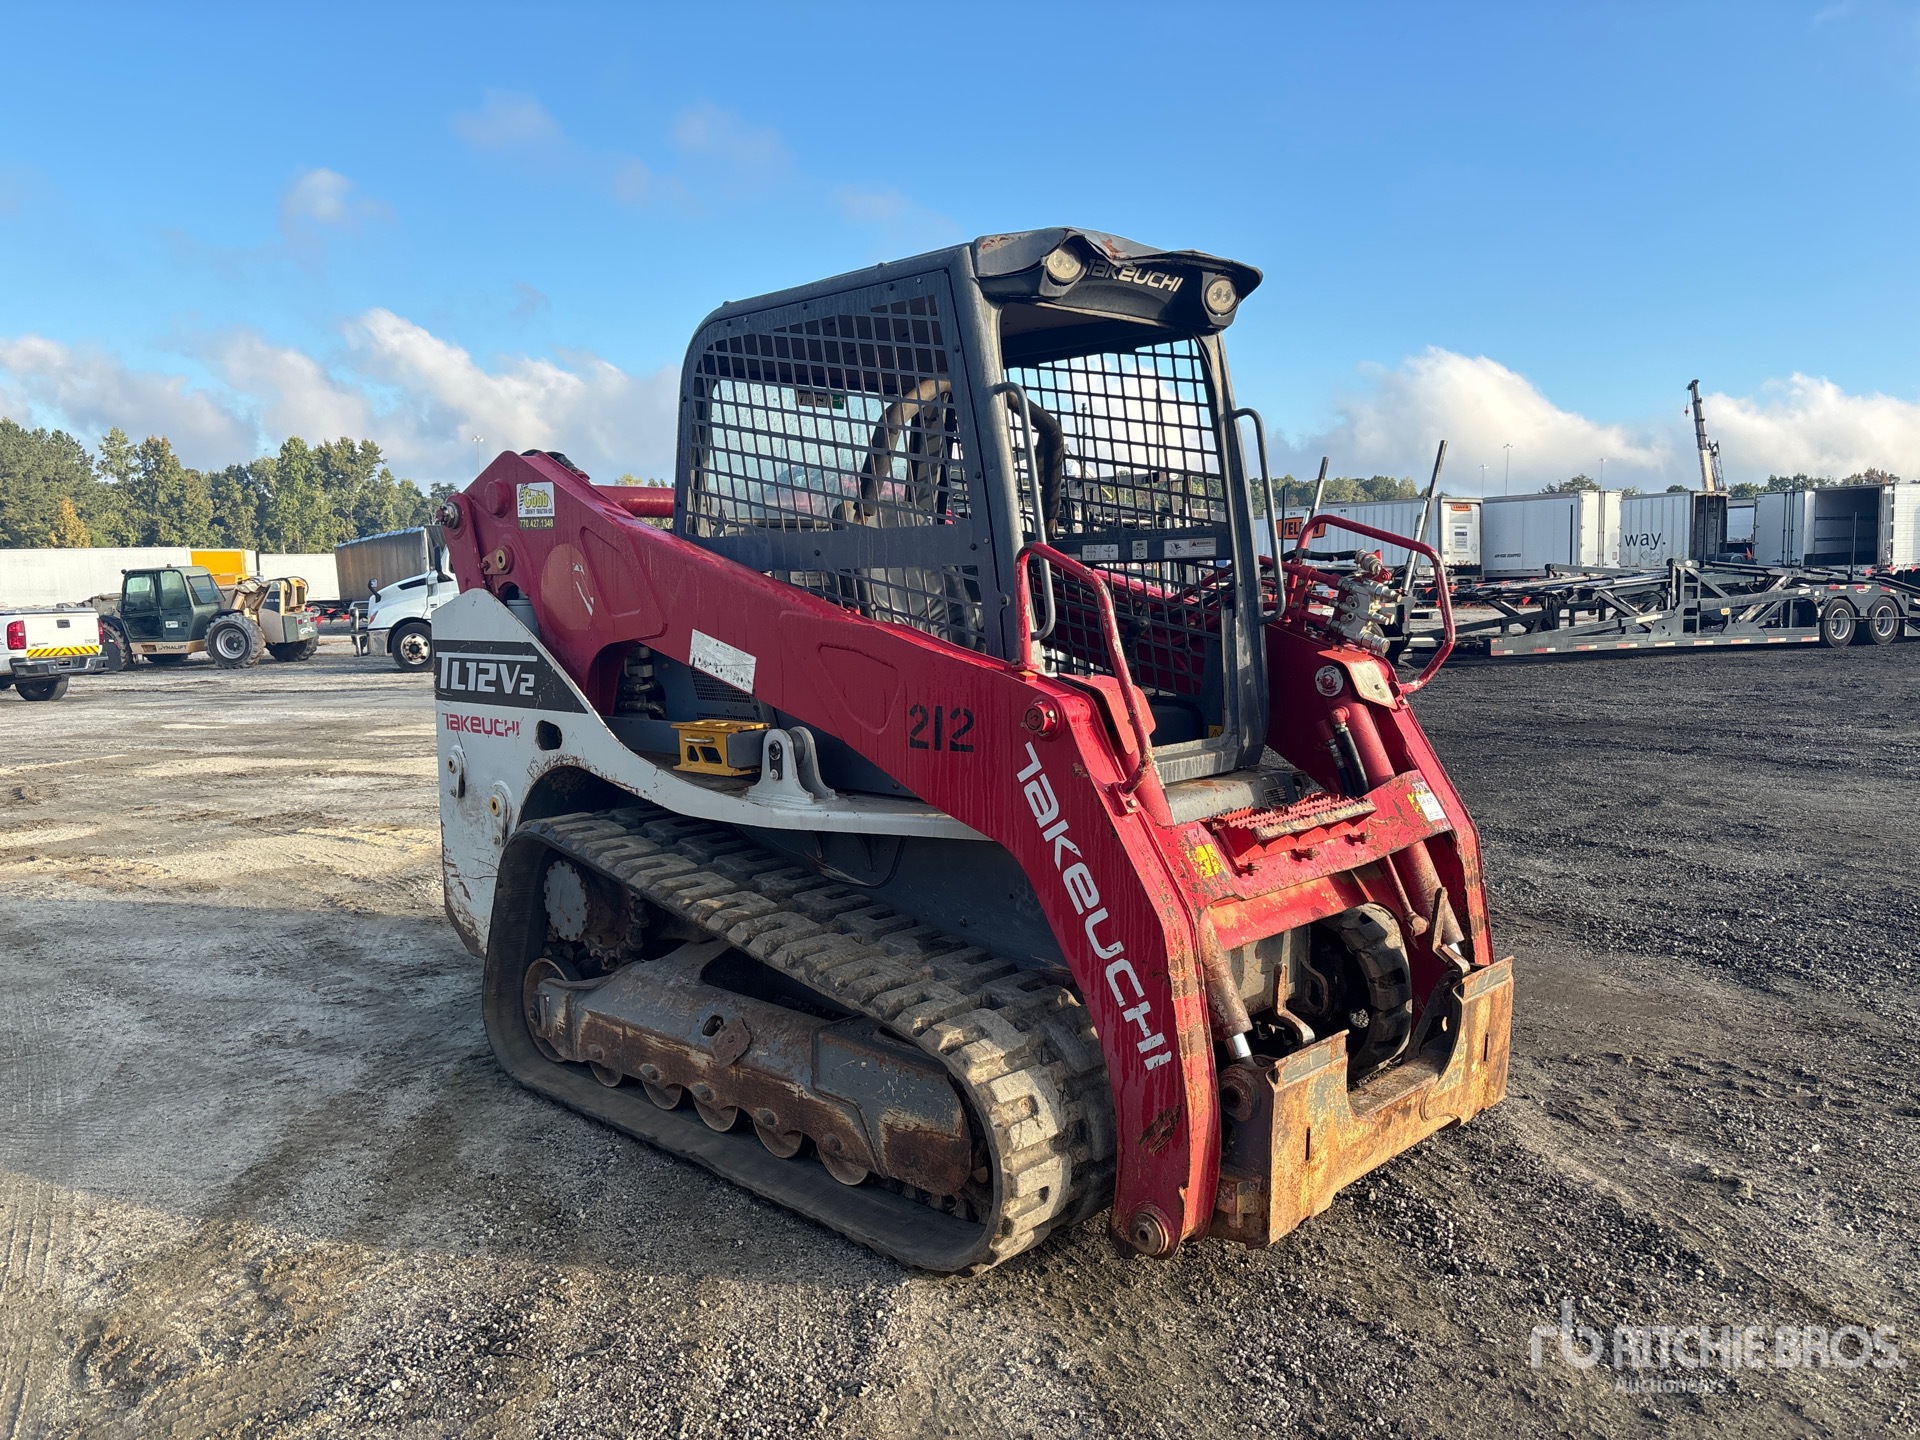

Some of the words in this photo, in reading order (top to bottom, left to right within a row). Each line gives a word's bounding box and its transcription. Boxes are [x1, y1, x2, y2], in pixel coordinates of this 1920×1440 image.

[523, 488, 548, 508] Cobb
[1624, 532, 1667, 550] way.
[436, 652, 538, 696] TL12V2
[909, 704, 975, 752] 212
[1016, 741, 1172, 1070] TAKEUCHI
